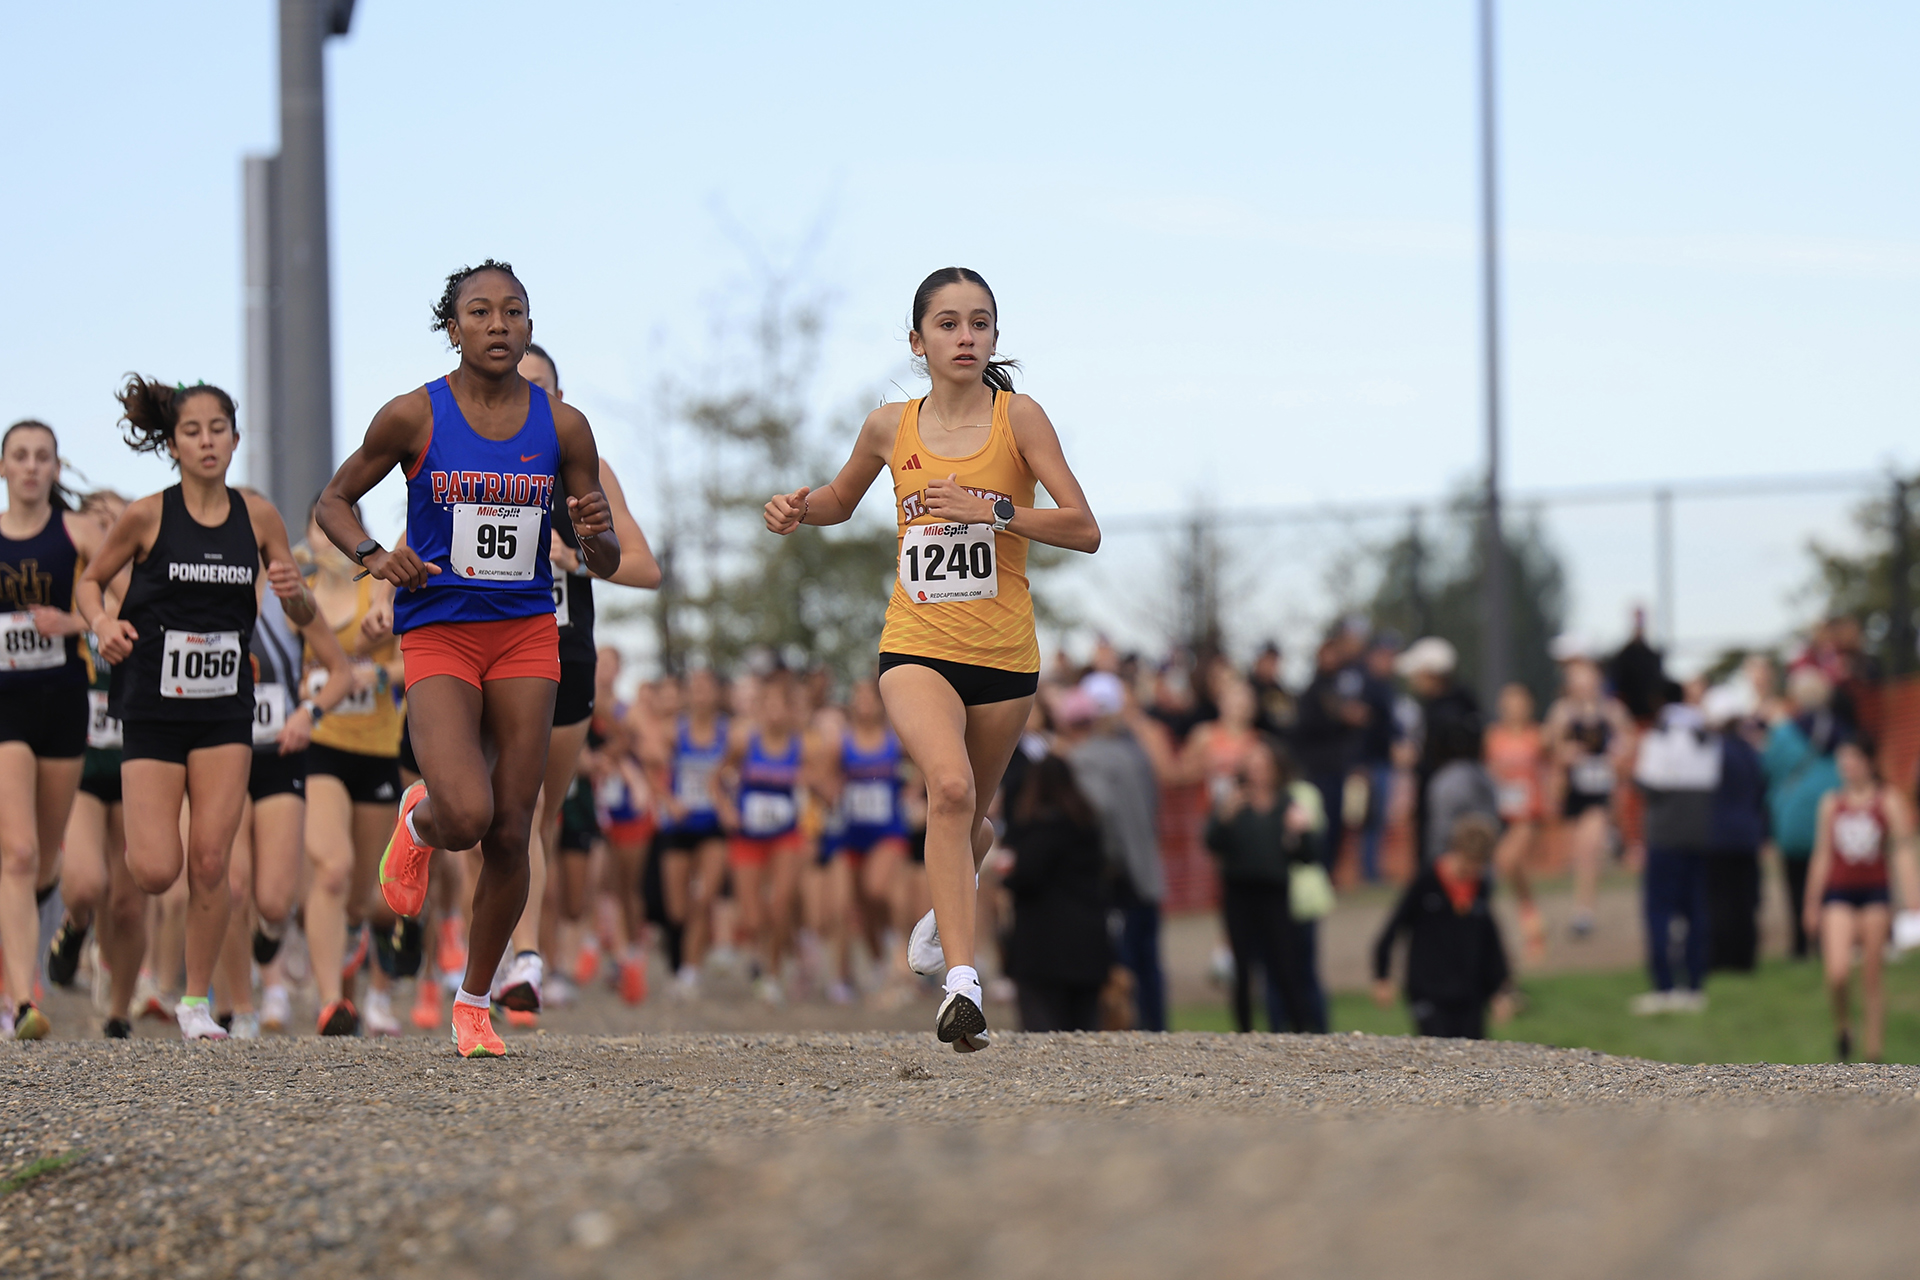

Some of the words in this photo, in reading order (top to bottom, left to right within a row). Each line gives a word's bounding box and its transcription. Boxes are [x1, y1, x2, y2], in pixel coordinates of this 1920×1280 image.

[476, 506, 521, 519] MileSplit
[477, 524, 518, 560] 95
[923, 524, 969, 537] MileSplit
[906, 542, 992, 581] 1240
[169, 562, 253, 585] PONDEROSA
[930, 590, 982, 599] REDCAPTIMING.COM
[169, 649, 237, 679] 1056
